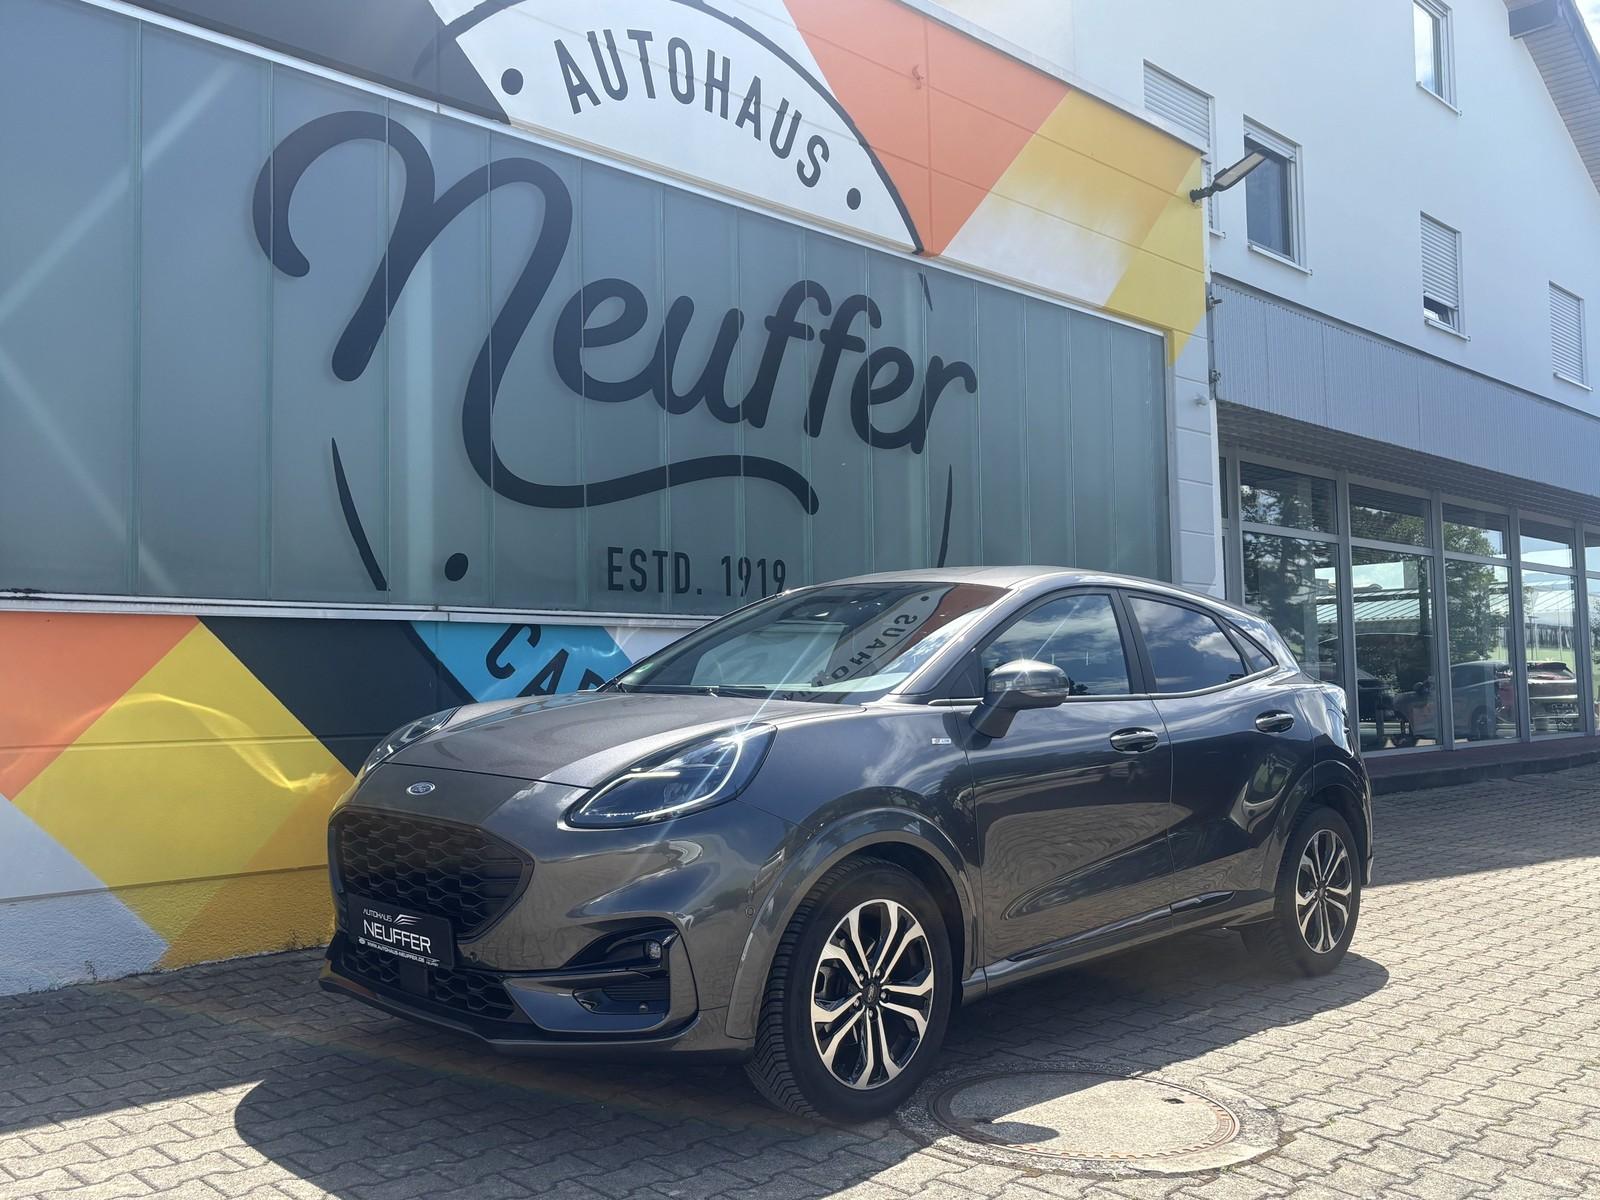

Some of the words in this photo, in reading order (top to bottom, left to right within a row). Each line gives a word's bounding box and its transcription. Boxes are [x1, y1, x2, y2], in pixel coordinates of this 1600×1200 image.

[553, 29, 829, 188] AUTOHAUS
[607, 546, 702, 595] ESTD.
[721, 555, 786, 597] 1919
[362, 908, 393, 922] AUTOHAUS
[363, 919, 431, 953] NEUFFER
